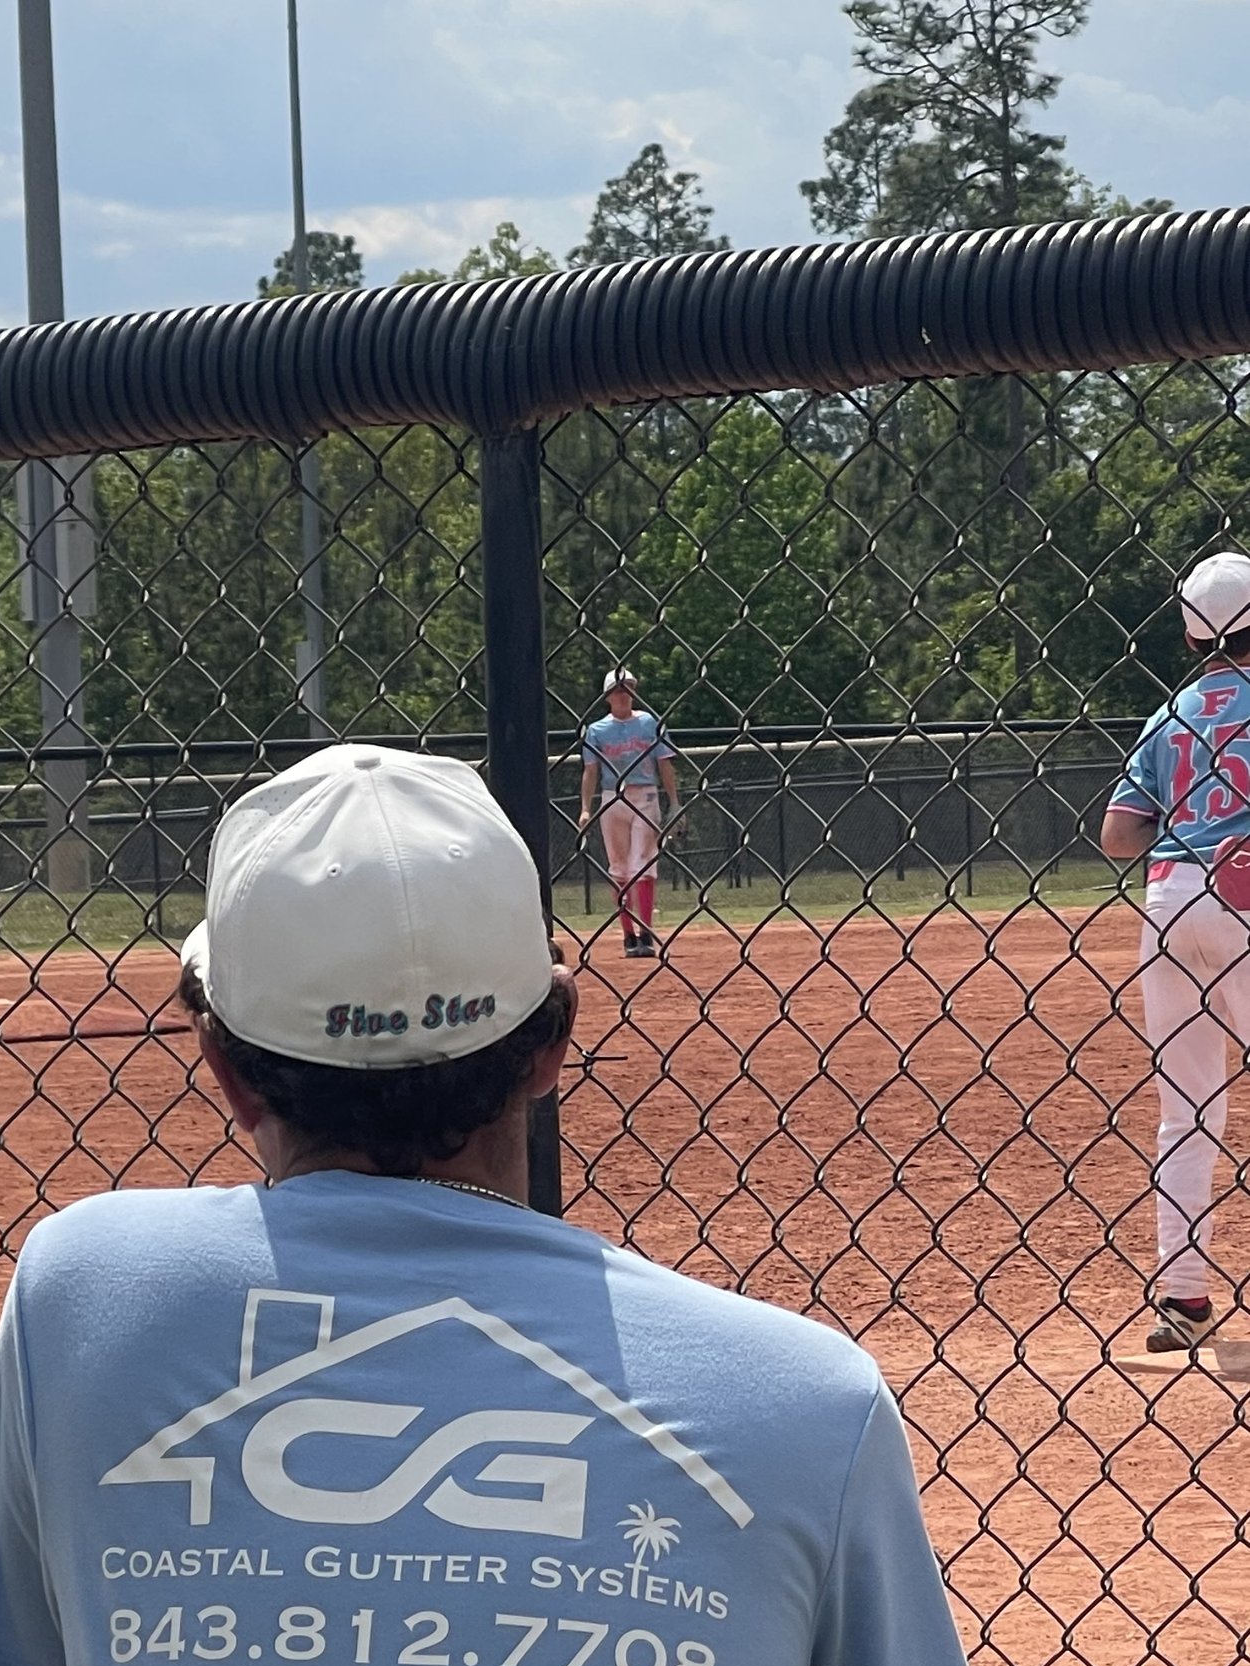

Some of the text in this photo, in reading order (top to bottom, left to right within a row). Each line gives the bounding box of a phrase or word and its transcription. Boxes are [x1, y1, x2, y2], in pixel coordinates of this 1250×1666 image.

[1168, 720, 1250, 827] 15
[325, 993, 496, 1038] Five Star
[241, 1399, 597, 1540] CG
[101, 1546, 730, 1620] COASTAL GUTTER SYSTEMS
